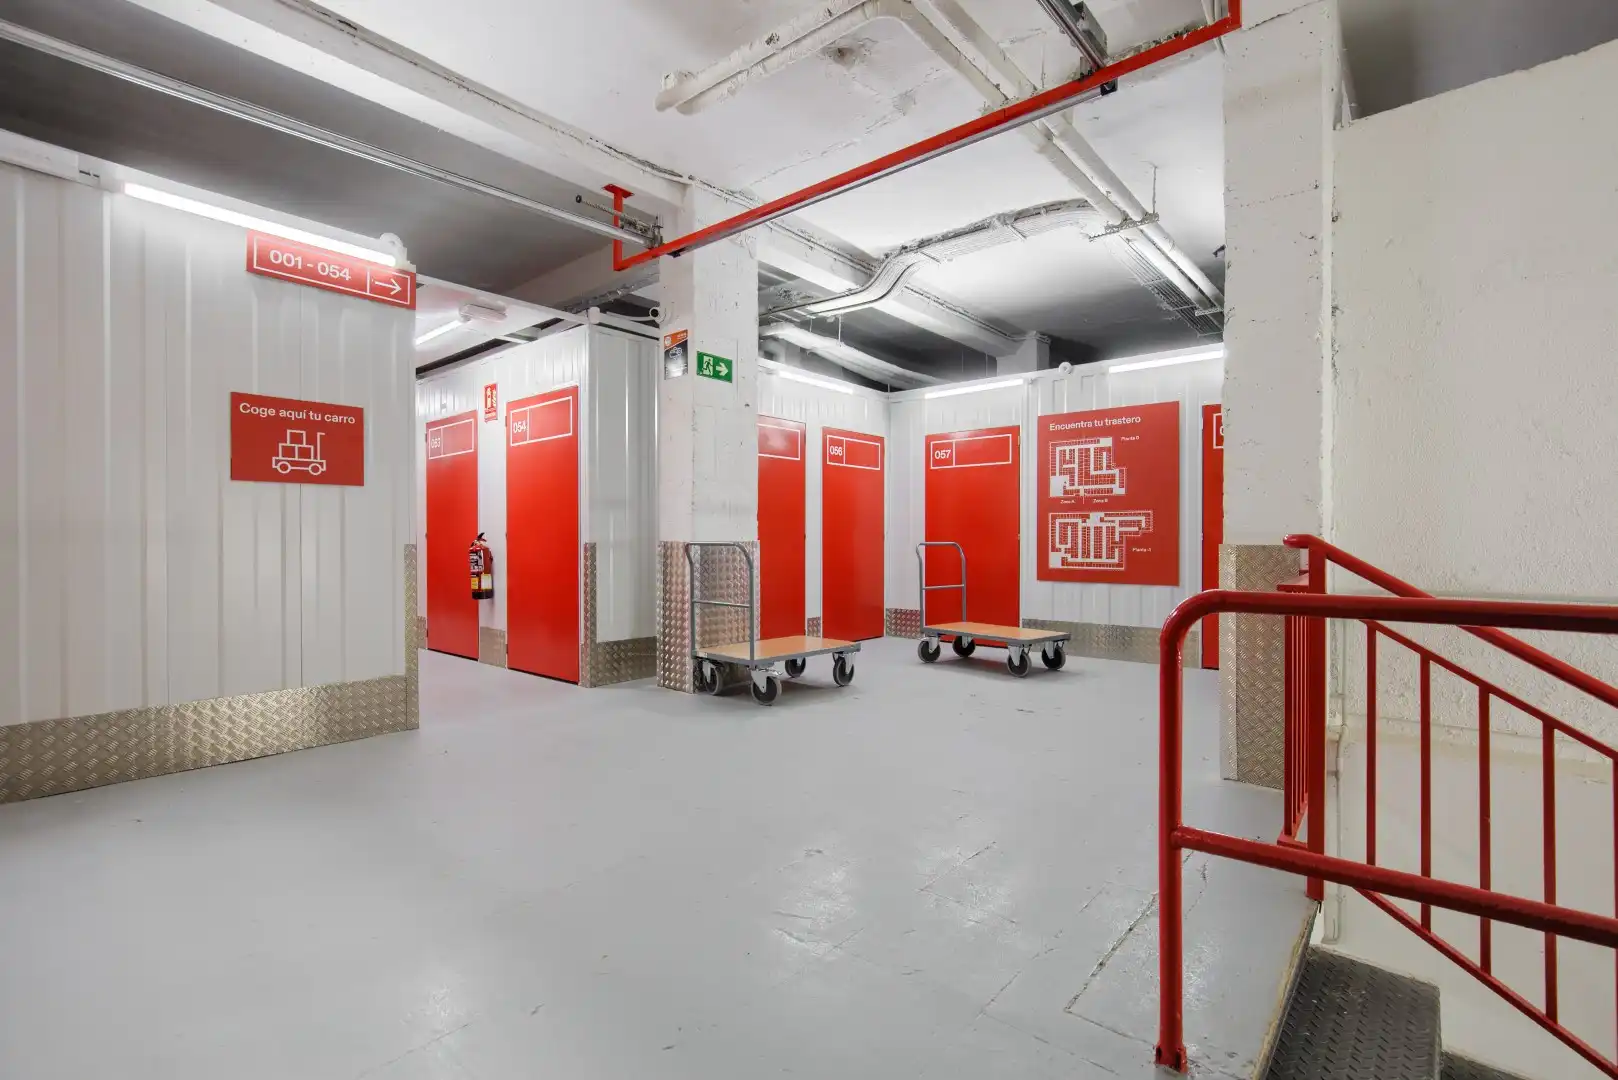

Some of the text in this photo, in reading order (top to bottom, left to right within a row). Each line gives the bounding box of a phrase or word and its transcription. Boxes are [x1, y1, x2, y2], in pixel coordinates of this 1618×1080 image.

[269, 249, 303, 270] 001
[317, 261, 352, 282] 054
[239, 402, 356, 424] Coge aquí tu carro
[513, 420, 527, 434] 054
[1049, 416, 1141, 431] Encuentra tu trastero
[829, 445, 843, 456] 056
[934, 449, 952, 460] 057
